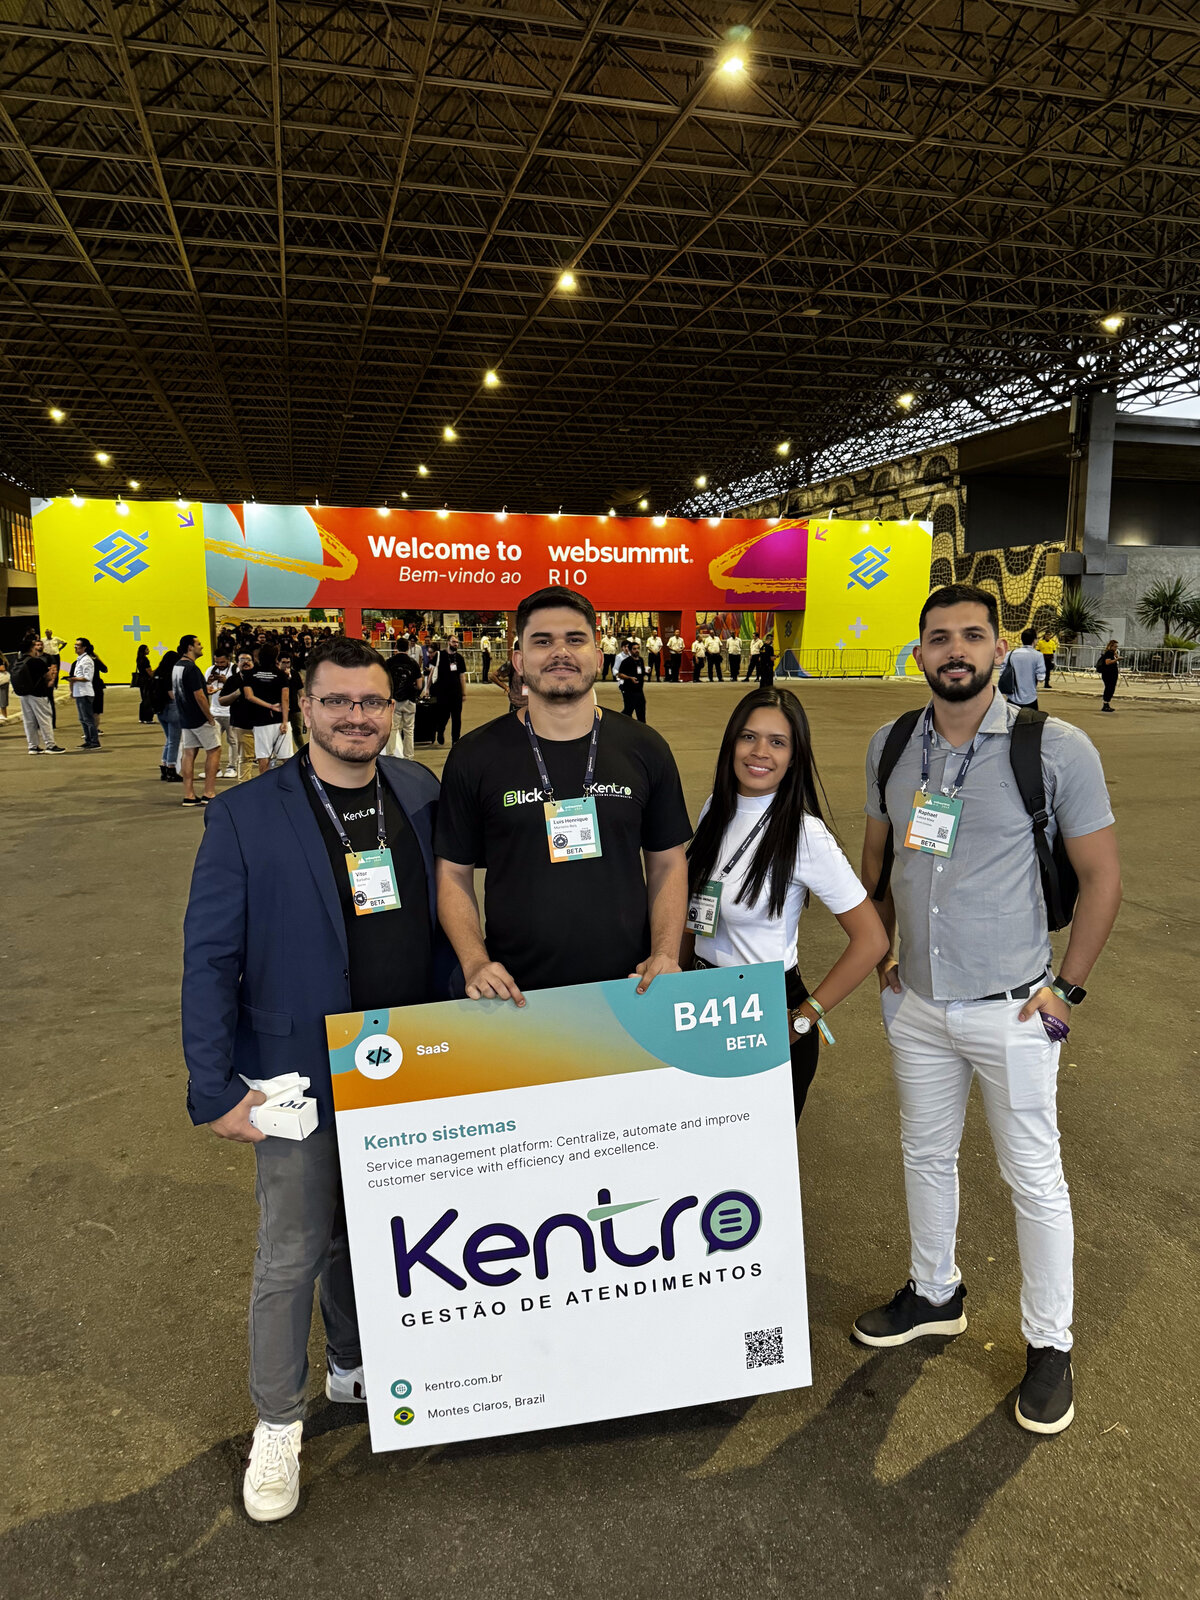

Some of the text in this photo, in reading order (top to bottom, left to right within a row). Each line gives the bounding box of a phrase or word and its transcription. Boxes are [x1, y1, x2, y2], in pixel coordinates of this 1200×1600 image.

[367, 535, 522, 561] Welcome to
[399, 566, 522, 584] Bem-vindo ao
[548, 568, 588, 586] RIO
[589, 782, 632, 796] Kentro
[342, 807, 376, 822] Kentro
[917, 809, 938, 819] Raphael
[566, 847, 583, 855] BETA
[920, 839, 936, 848] BETA
[370, 899, 385, 907] BETA
[693, 923, 705, 931] BETA
[673, 993, 764, 1032] B414
[416, 1041, 450, 1056] SaaS
[726, 1033, 768, 1051] BETA
[364, 1119, 517, 1151] Kentro sistemas
[366, 1112, 750, 1173] Service management platform: Centralize, automate and improve
[367, 1141, 659, 1188] customer service with efficiency and excellence.
[390, 1188, 763, 1298] Kentro
[401, 1262, 763, 1328] GESTÃO DE ATENDIMENTOS
[424, 1373, 503, 1392] kentro.com.br
[427, 1394, 545, 1419] Montes Claros, Brazil
